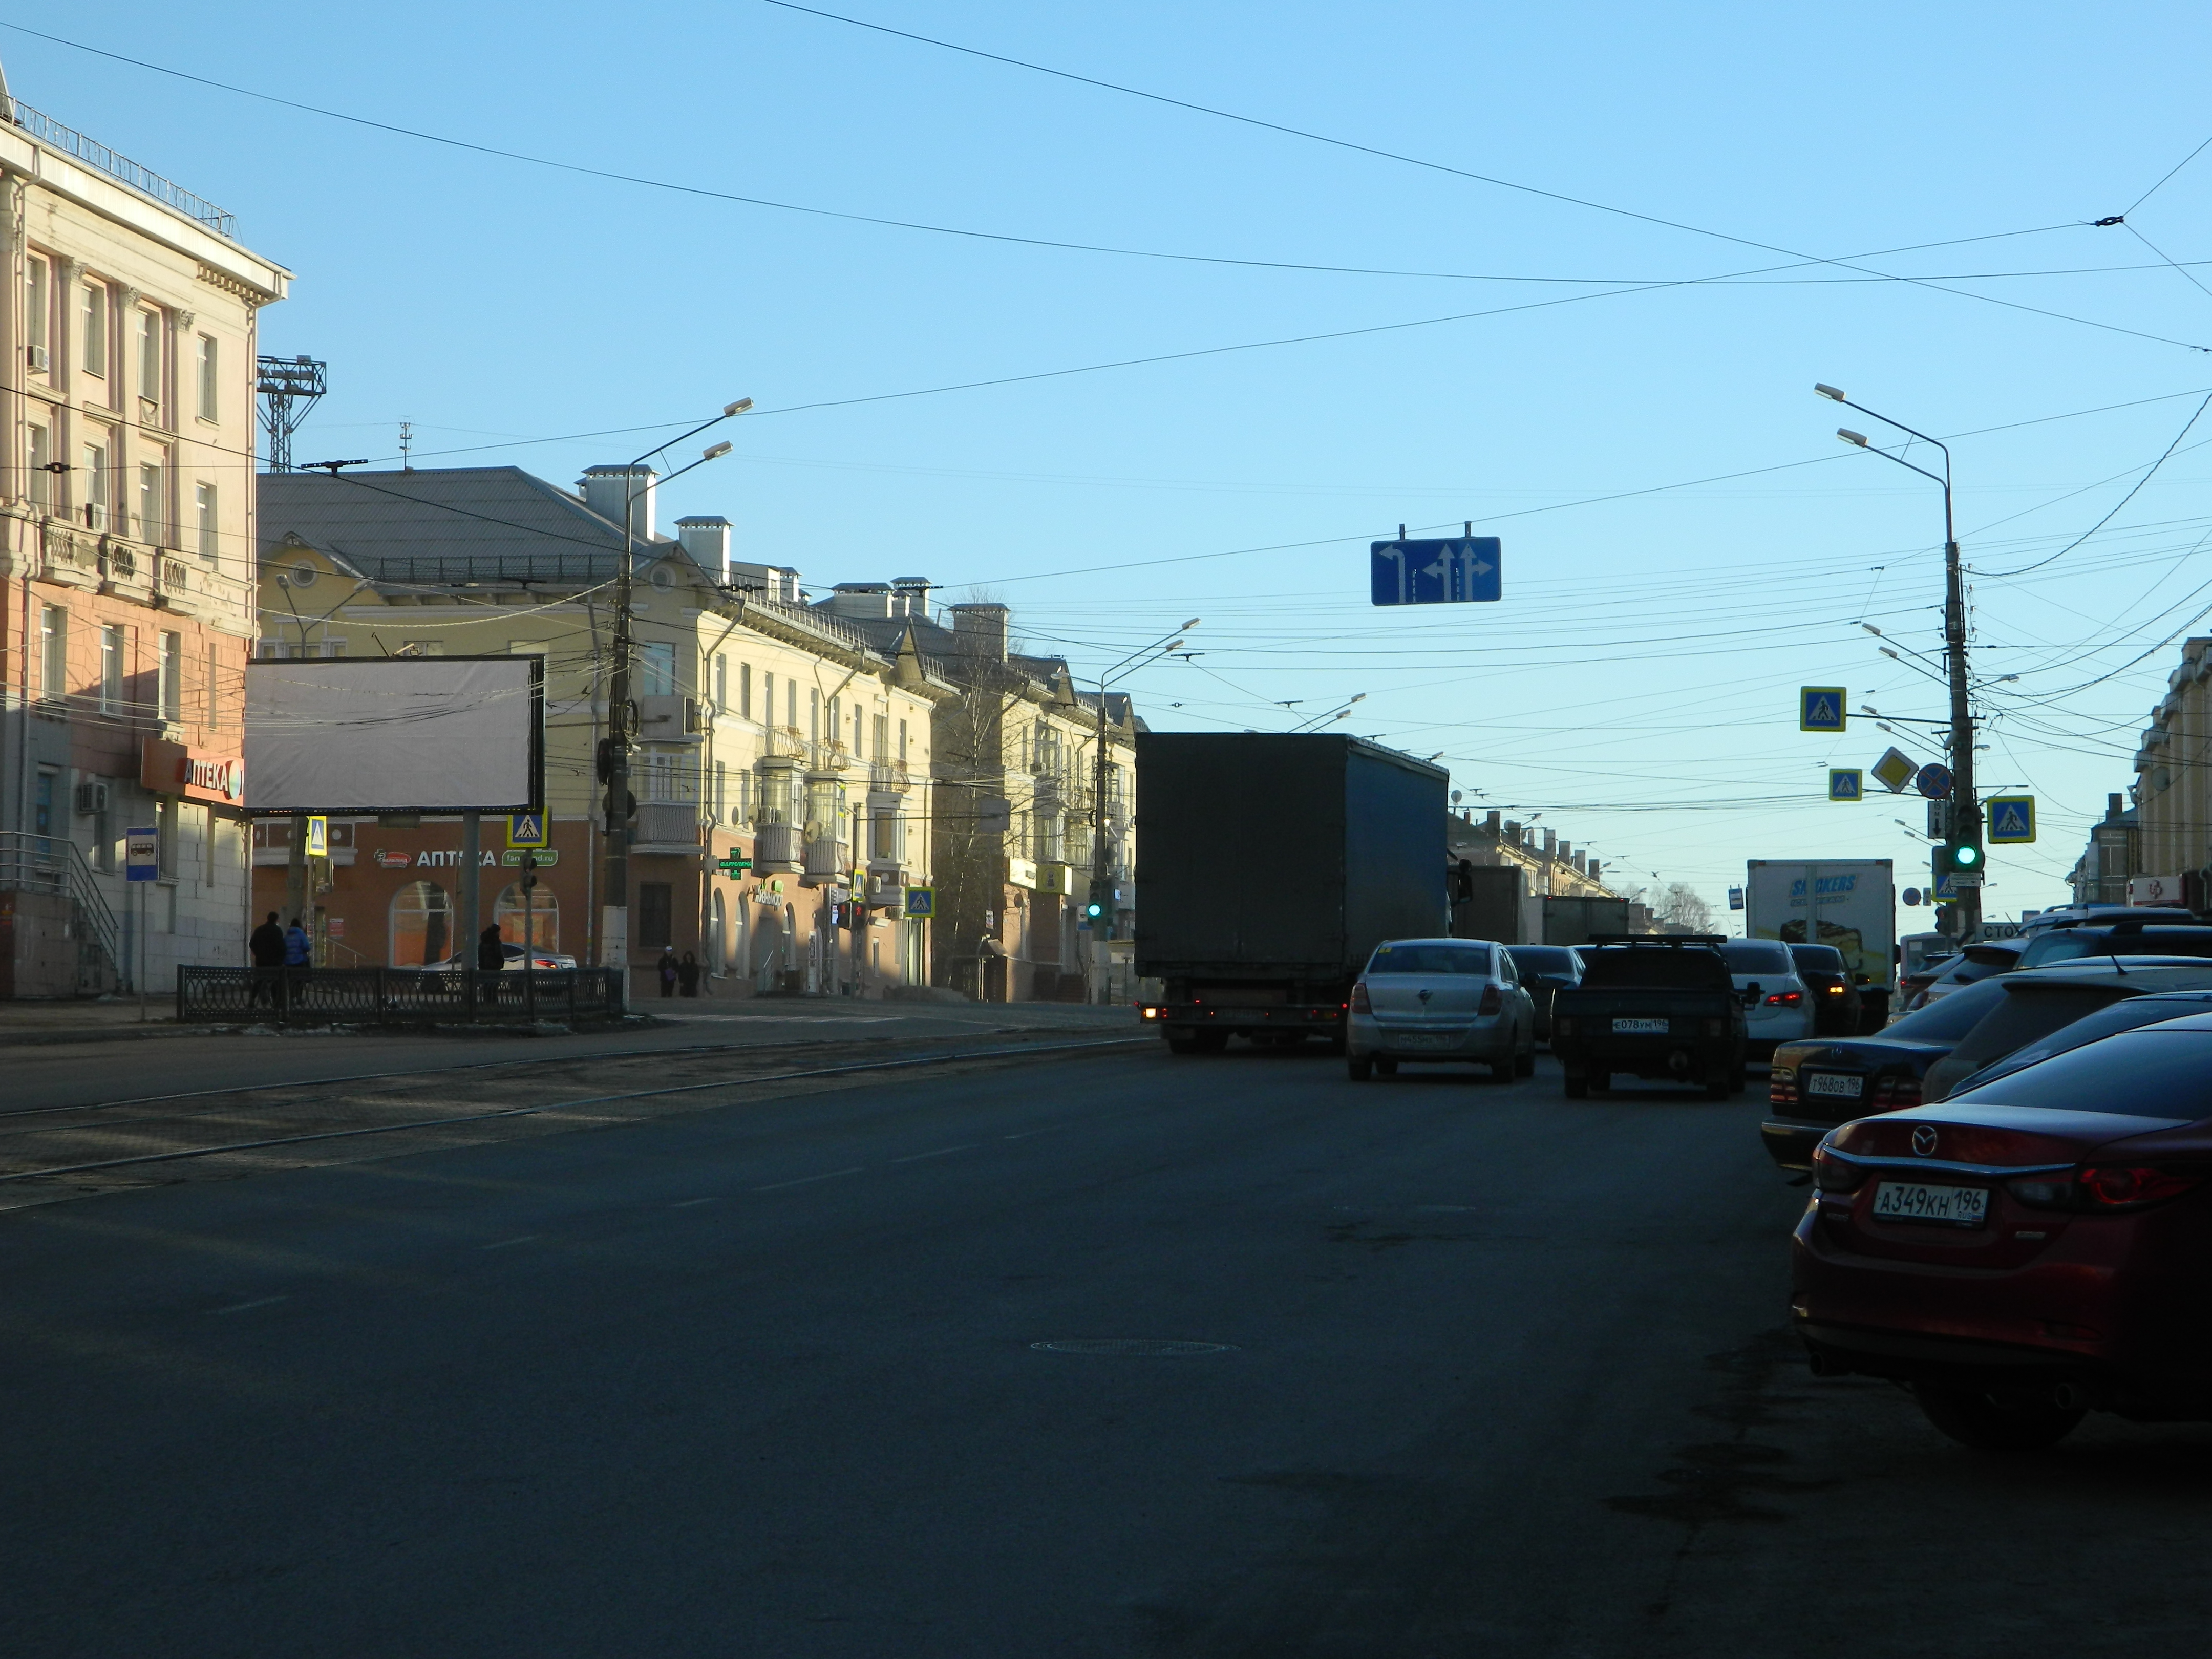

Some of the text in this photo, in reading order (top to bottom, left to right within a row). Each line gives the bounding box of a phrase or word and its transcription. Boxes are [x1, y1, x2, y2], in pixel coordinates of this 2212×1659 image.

[185, 758, 228, 792] АПТЕКА
[416, 850, 497, 867] АПТА
[1880, 1186, 1981, 1216] А349КН 196
[1958, 1211, 1971, 1220] RUS
